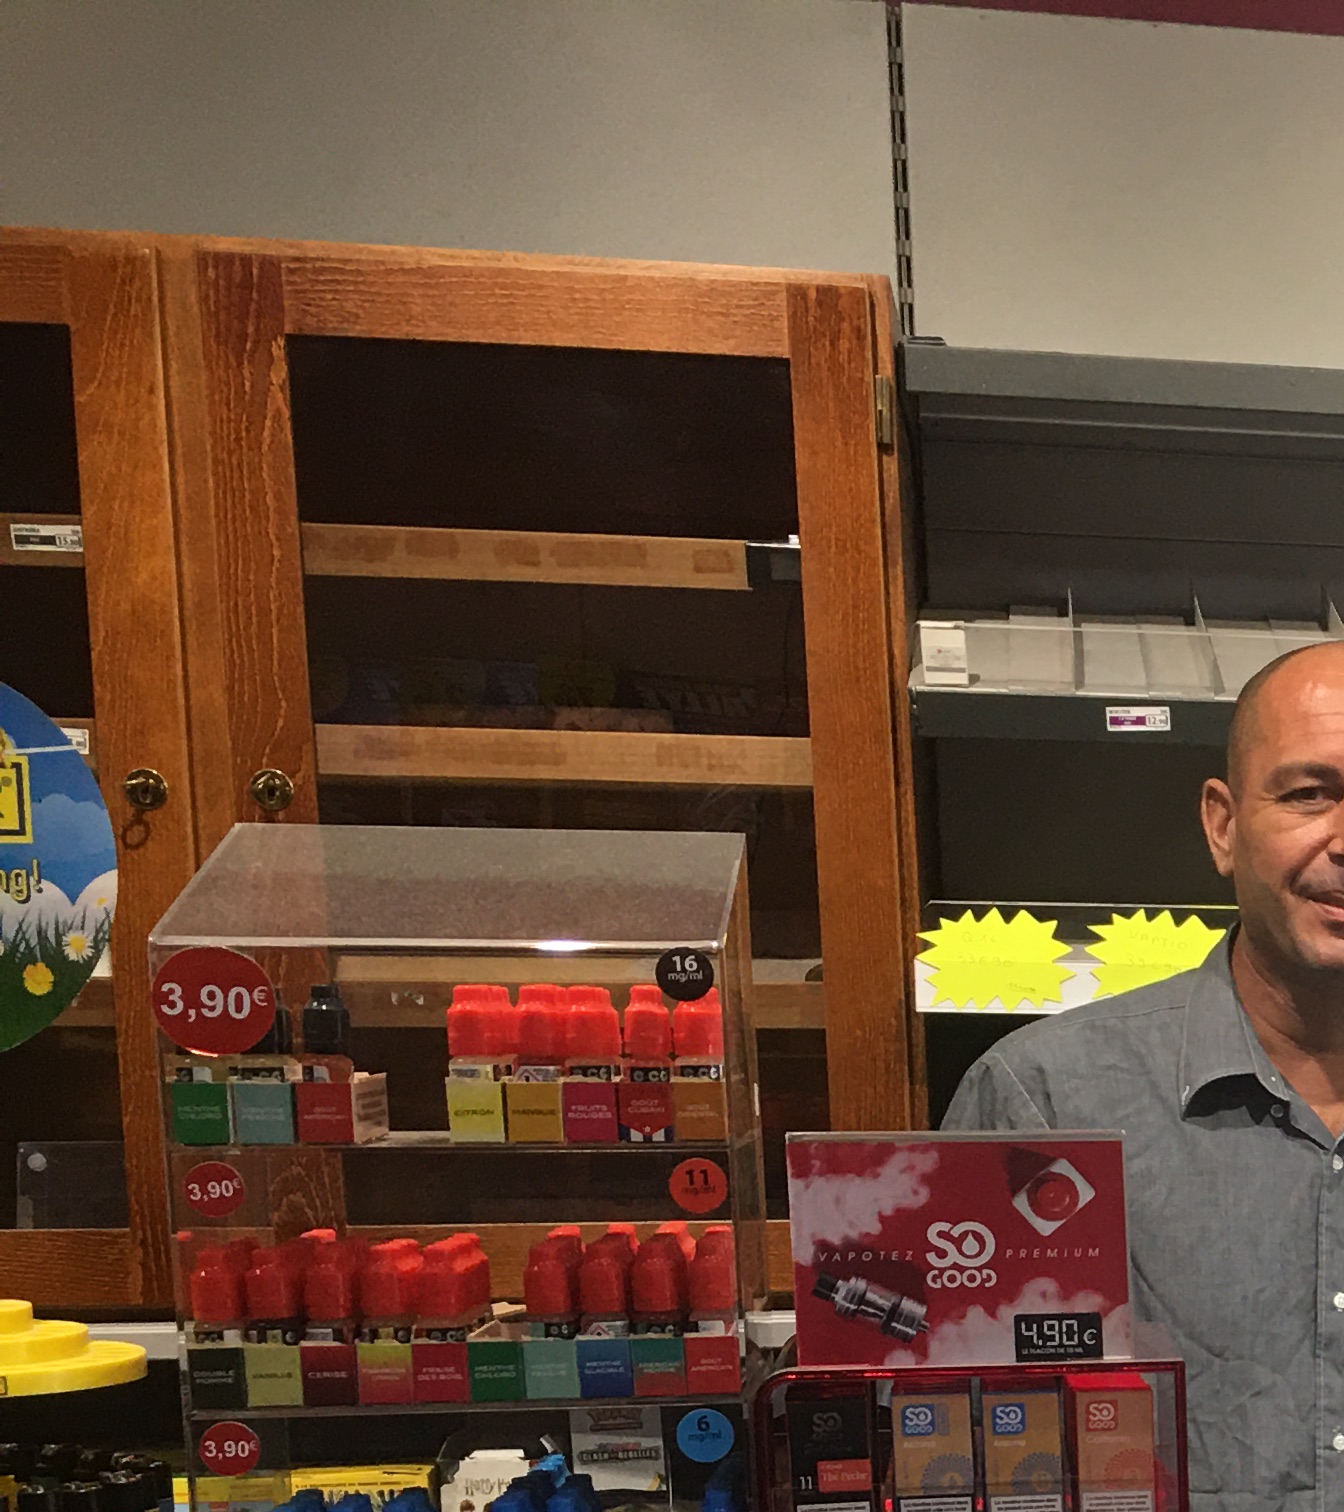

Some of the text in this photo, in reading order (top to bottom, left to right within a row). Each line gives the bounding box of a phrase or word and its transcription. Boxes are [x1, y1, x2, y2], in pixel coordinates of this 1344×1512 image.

[671, 954, 698, 973] 16
[818, 1250, 914, 1262] VAPOTEZ
[1004, 1246, 1101, 1259] PREMIUM
